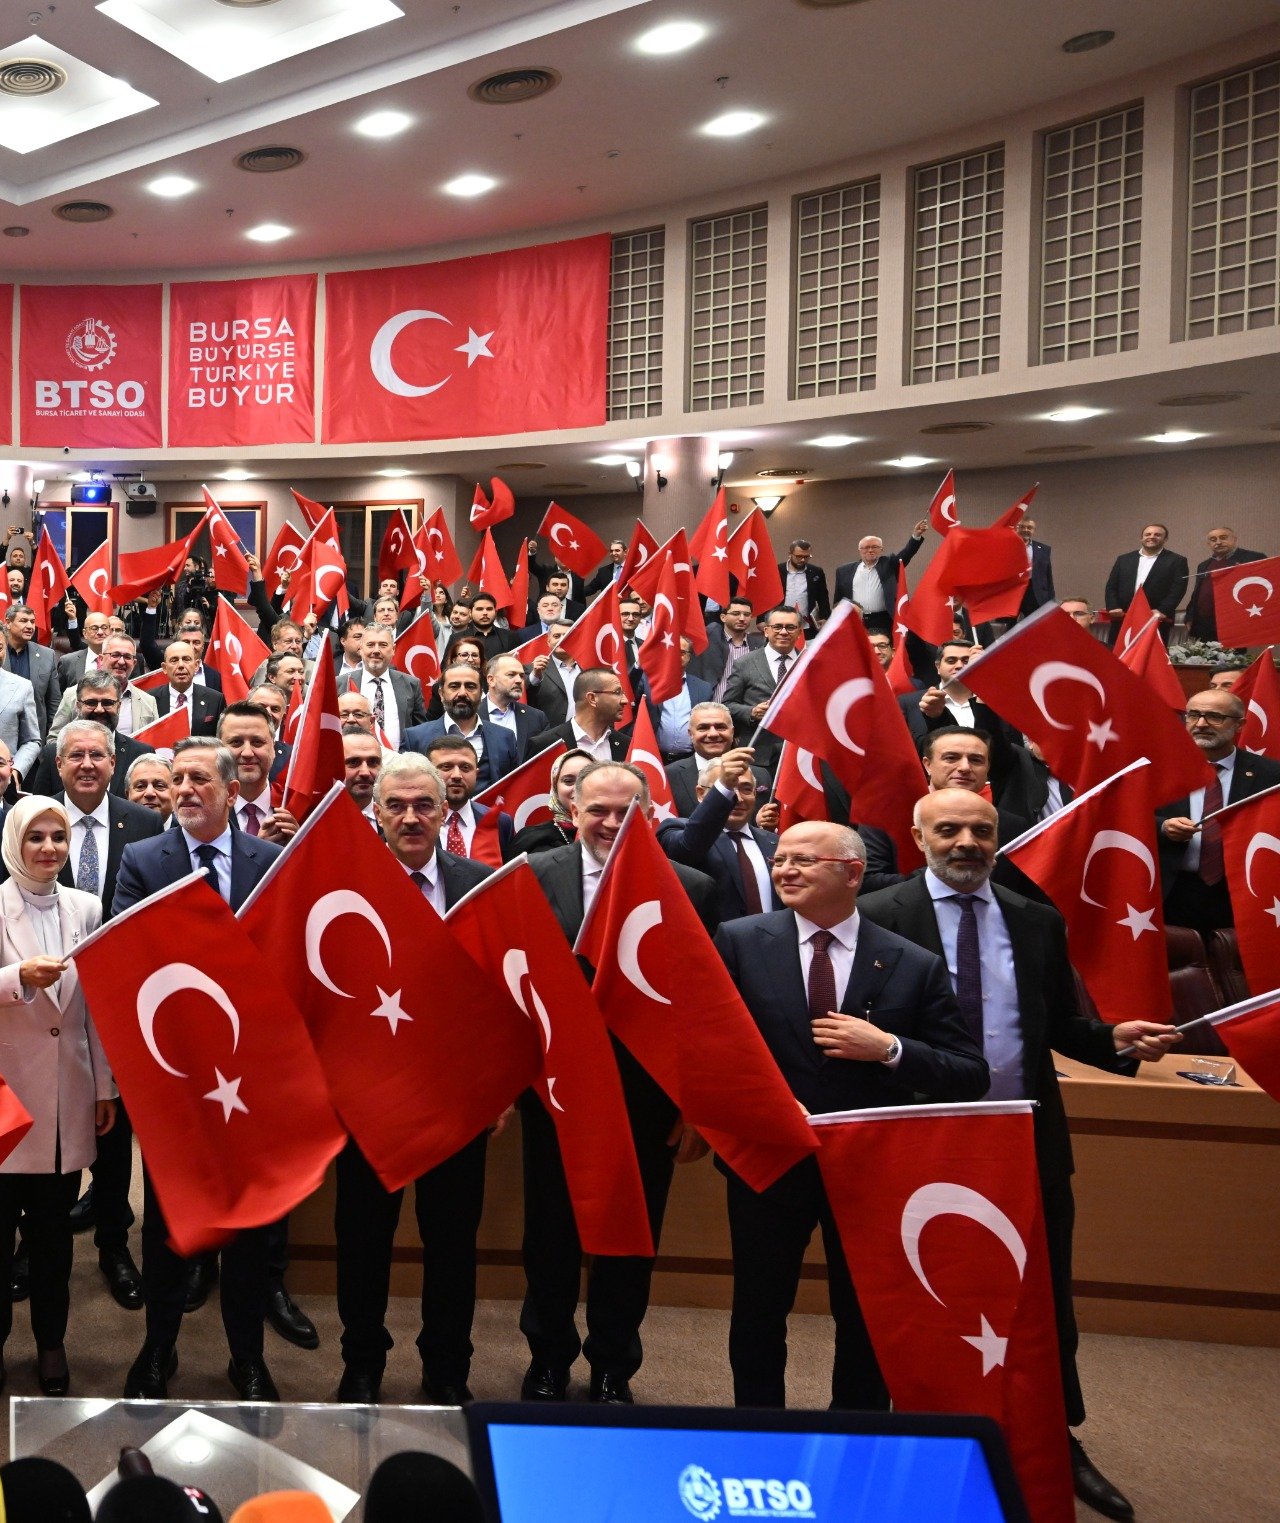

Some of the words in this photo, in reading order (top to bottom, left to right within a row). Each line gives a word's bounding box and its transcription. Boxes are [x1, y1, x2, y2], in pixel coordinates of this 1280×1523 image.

[189, 317, 295, 343] BURSA
[189, 341, 295, 363] BÜYÜRSE
[189, 361, 295, 383] TÜRKİYE
[35, 380, 145, 409] BTSO
[188, 383, 295, 408] BÜYÜR
[98, 409, 123, 417] SANAYİ
[722, 1478, 813, 1511] BTSO
